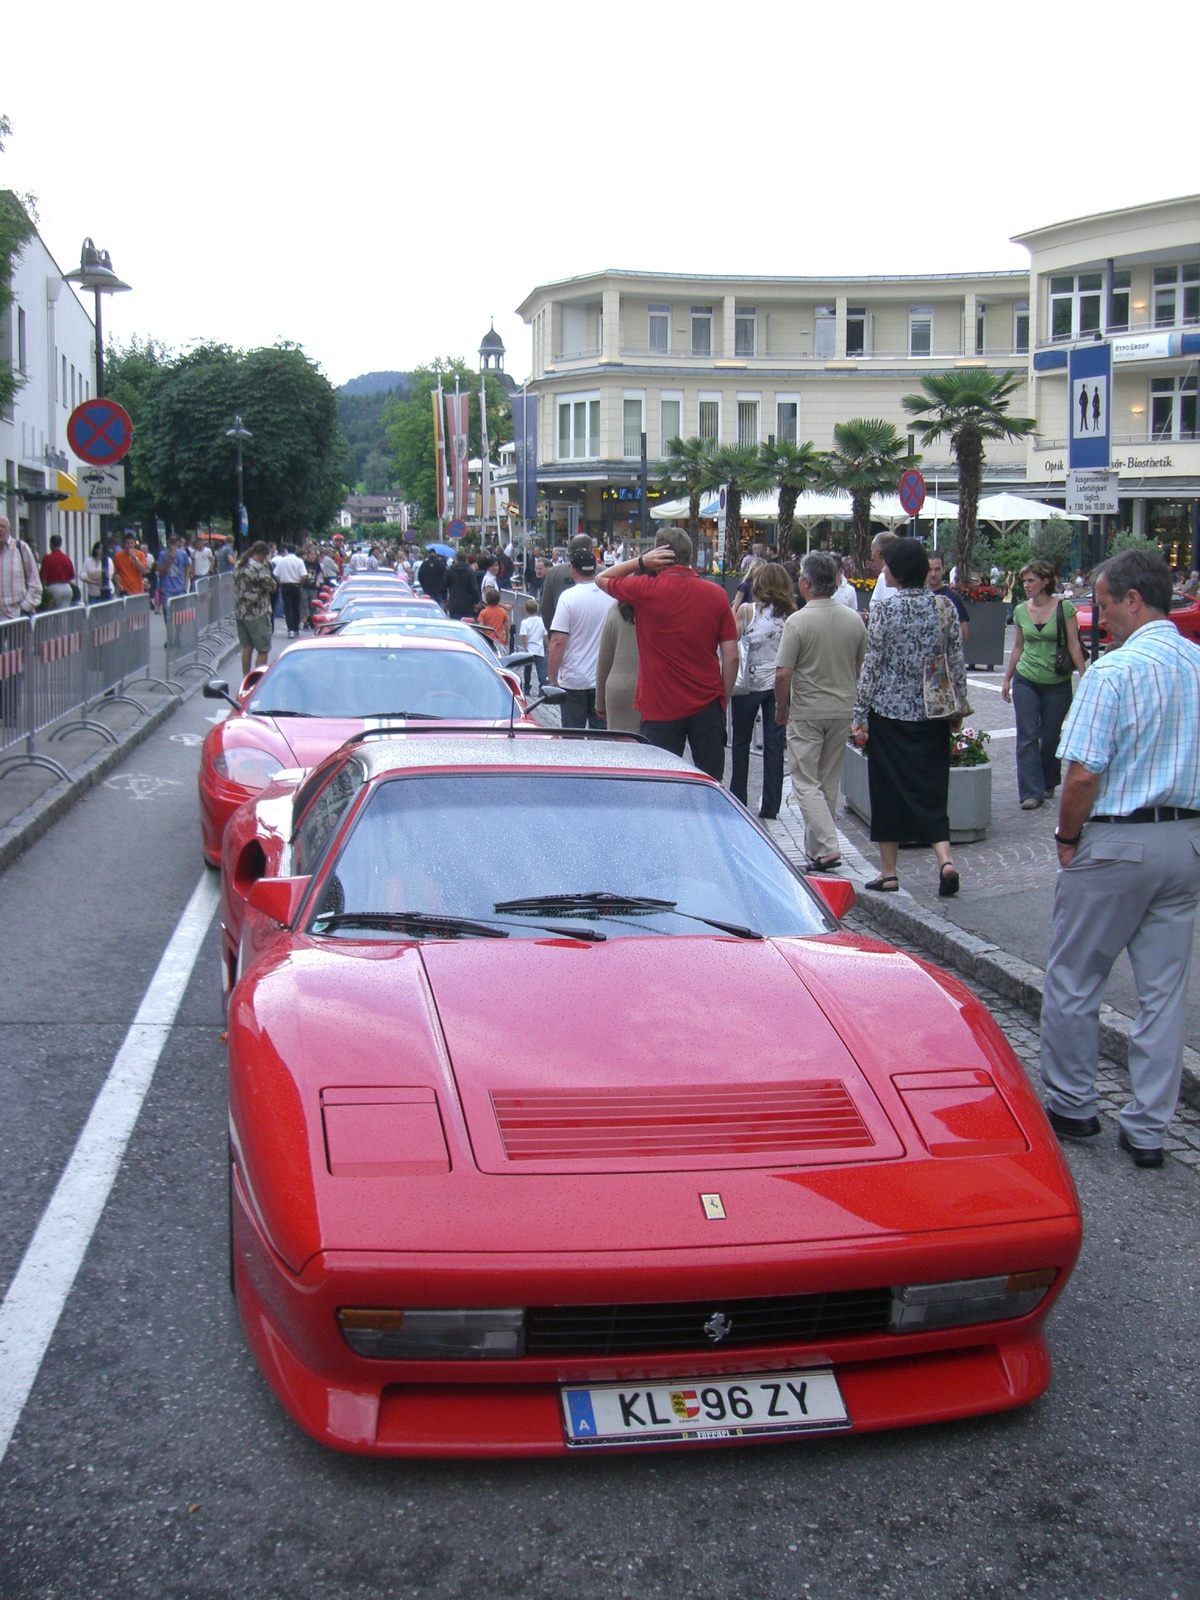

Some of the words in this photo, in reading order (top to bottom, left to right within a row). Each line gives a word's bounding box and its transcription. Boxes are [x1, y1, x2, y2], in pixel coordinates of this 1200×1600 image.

[1044, 459, 1064, 474] Optik
[1075, 476, 1109, 485] Ausgenommen
[90, 484, 113, 495] Zone
[1076, 485, 1107, 494] Ladetätigkeit
[1083, 493, 1099, 503] täglich
[89, 502, 114, 510] ANFANG
[1106, 503, 1115, 511] Uhr
[618, 1391, 672, 1427] KL
[700, 1386, 753, 1421] 96
[760, 1381, 809, 1416] ZY
[578, 1419, 591, 1432] A
